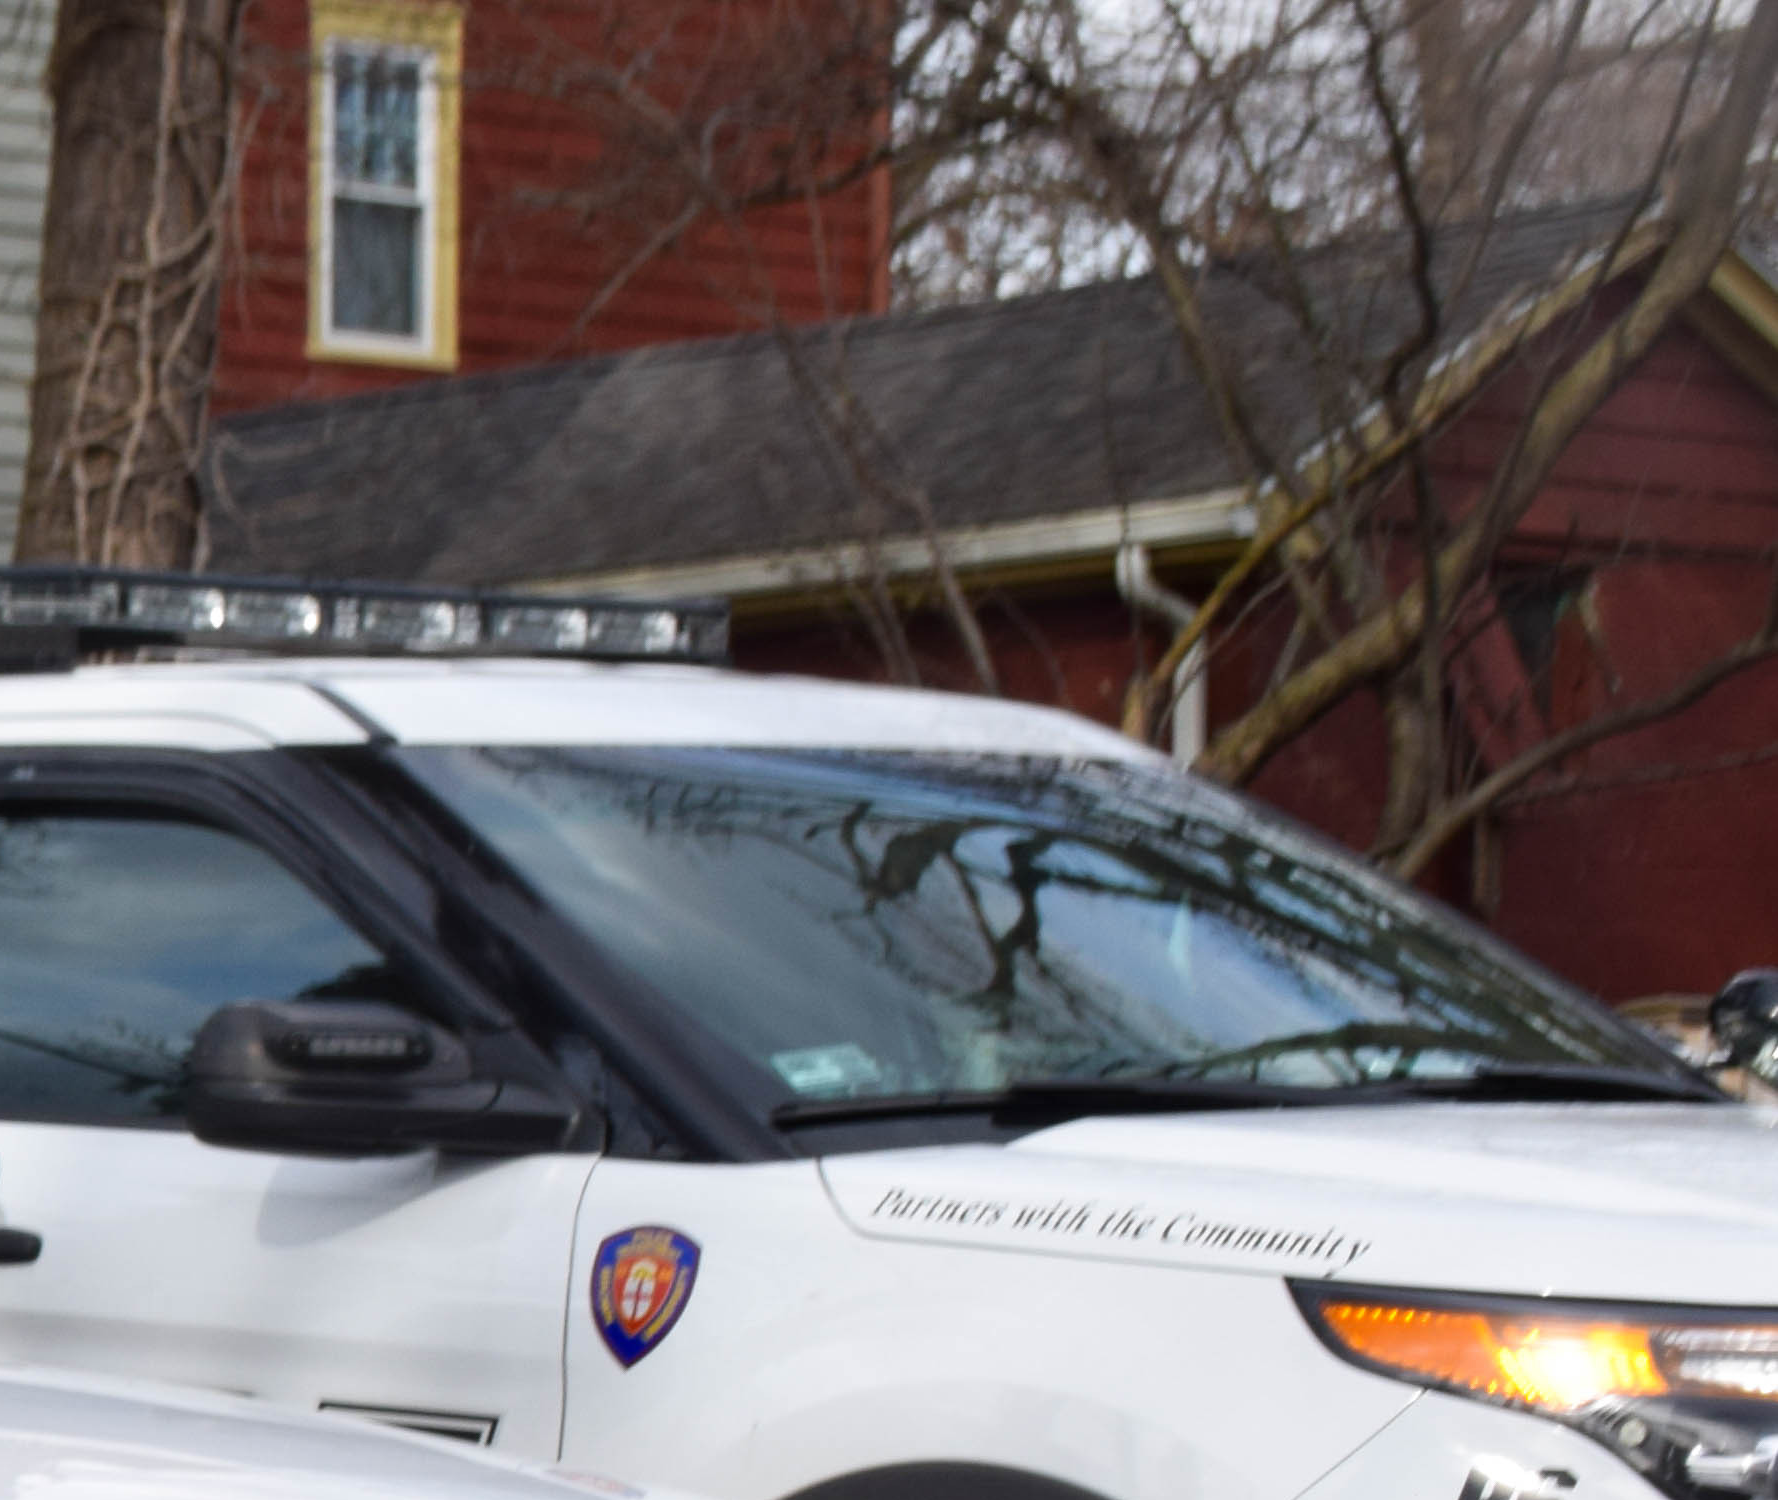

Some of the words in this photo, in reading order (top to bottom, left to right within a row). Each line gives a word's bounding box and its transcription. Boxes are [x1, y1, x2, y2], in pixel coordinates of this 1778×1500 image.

[870, 1186, 1009, 1227] Partners
[1011, 1199, 1098, 1232] with
[1097, 1203, 1156, 1240] the
[1161, 1211, 1372, 1279] Community
